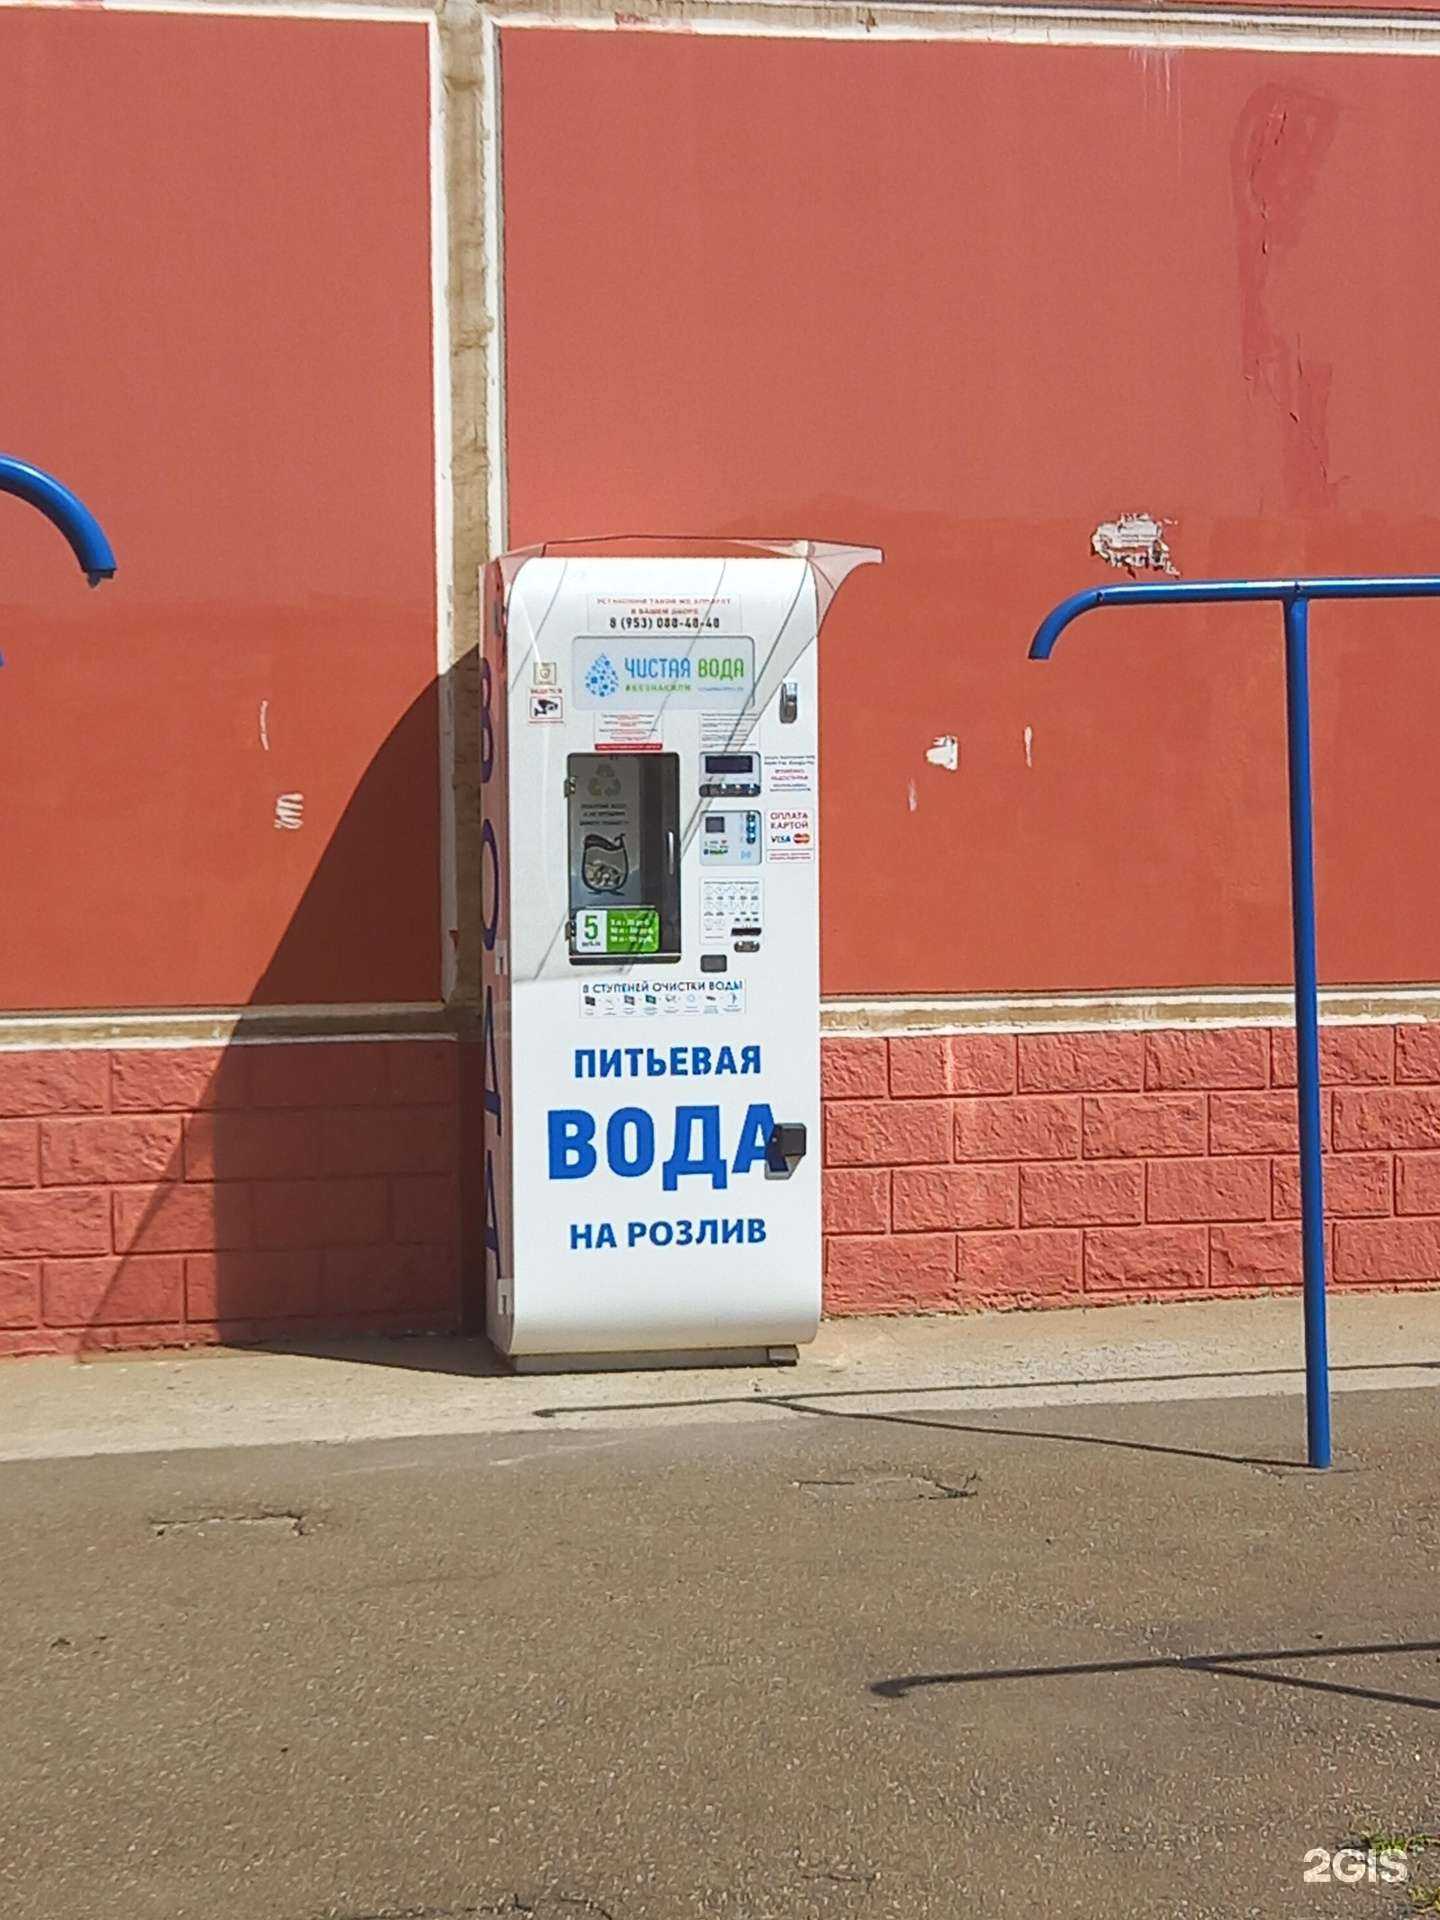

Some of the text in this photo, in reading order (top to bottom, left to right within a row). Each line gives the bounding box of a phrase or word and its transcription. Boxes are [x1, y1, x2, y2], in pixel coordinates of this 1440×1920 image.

[609, 616, 617, 629] 8
[620, 616, 653, 631] (953)
[625, 657, 744, 680] ЧИСТАЯ ВОДА
[770, 812, 808, 820] ОПЛАТА
[770, 821, 808, 829] КАРТОЙ
[770, 835, 791, 843] VISA
[584, 915, 598, 940] 5
[593, 981, 649, 994] СТУПЕНЕЙ
[653, 981, 705, 992] ОЧИСТКИ
[709, 980, 743, 991] ВОДЫ
[574, 1045, 761, 1078] ПИТЬЕВАЯ
[547, 1103, 789, 1191] ВОДА
[570, 1218, 767, 1249] НА РОЗЛИВ
